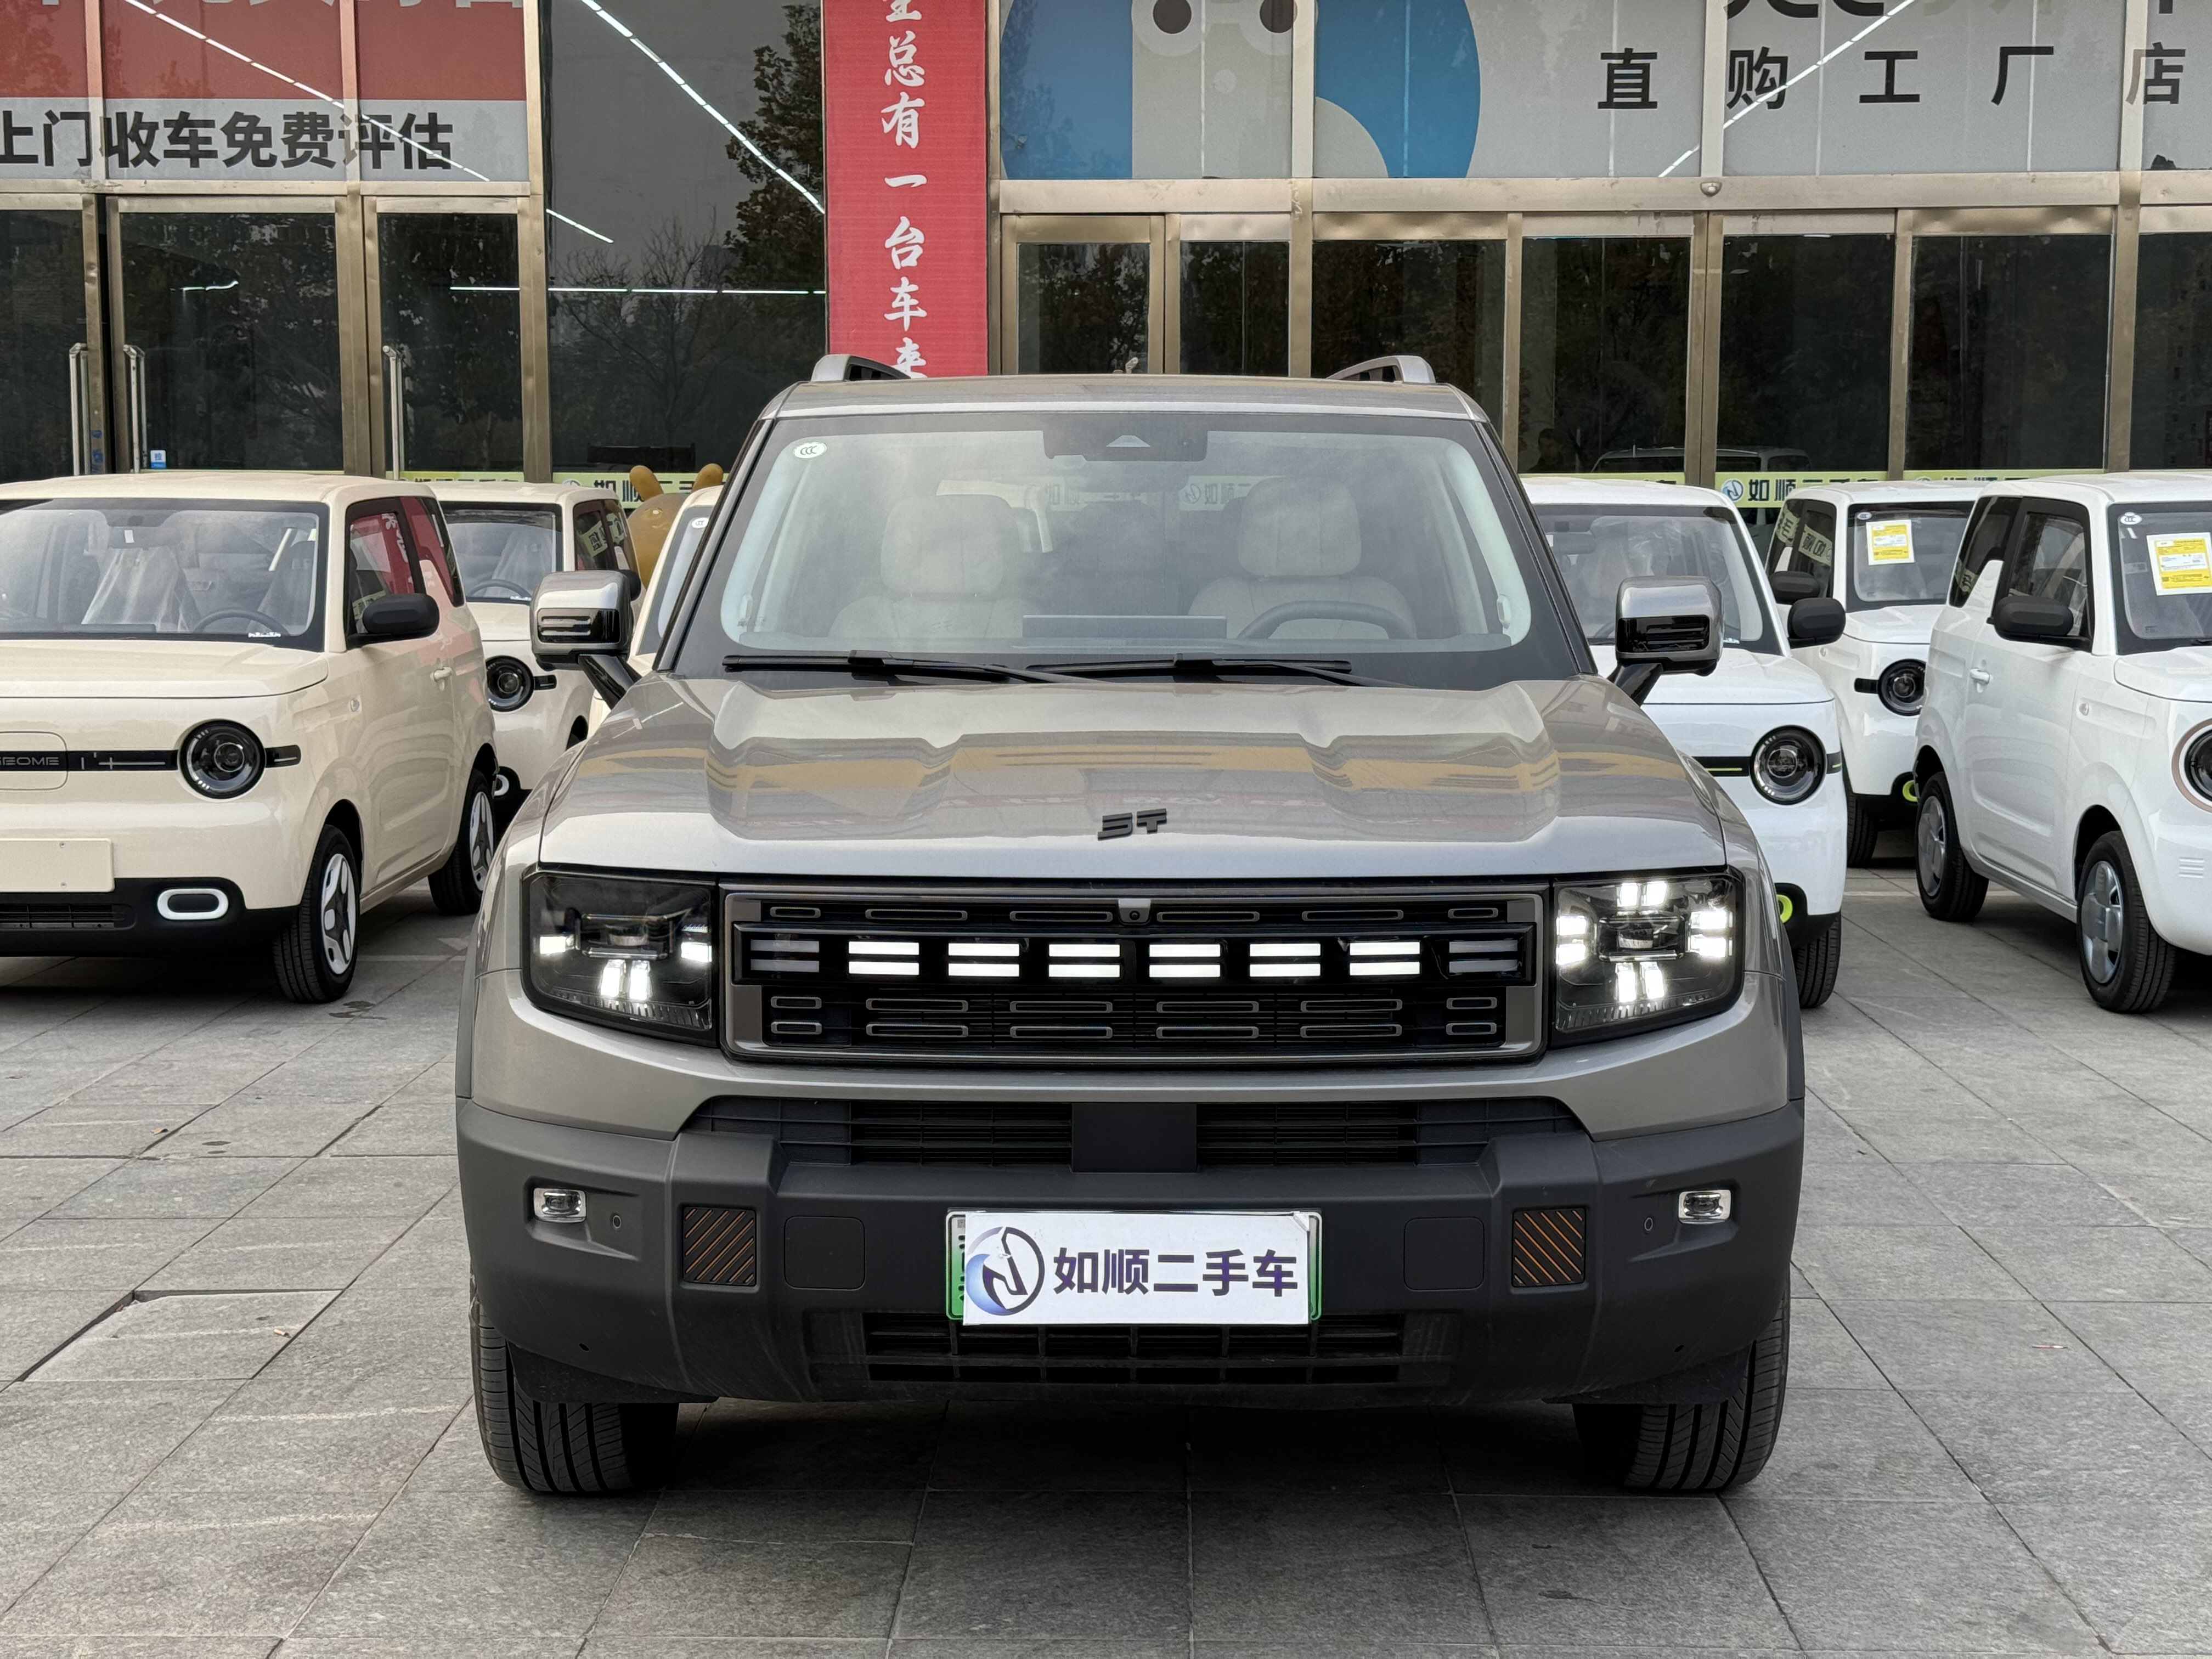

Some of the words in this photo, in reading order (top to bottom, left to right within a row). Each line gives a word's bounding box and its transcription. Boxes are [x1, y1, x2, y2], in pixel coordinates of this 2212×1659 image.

[1597, 42, 2186, 110] 直购工厂店
[0, 109, 454, 170] 上门收车免费评估
[0, 757, 59, 765] EOME
[1053, 1247, 1299, 1297] 如顺二手车
